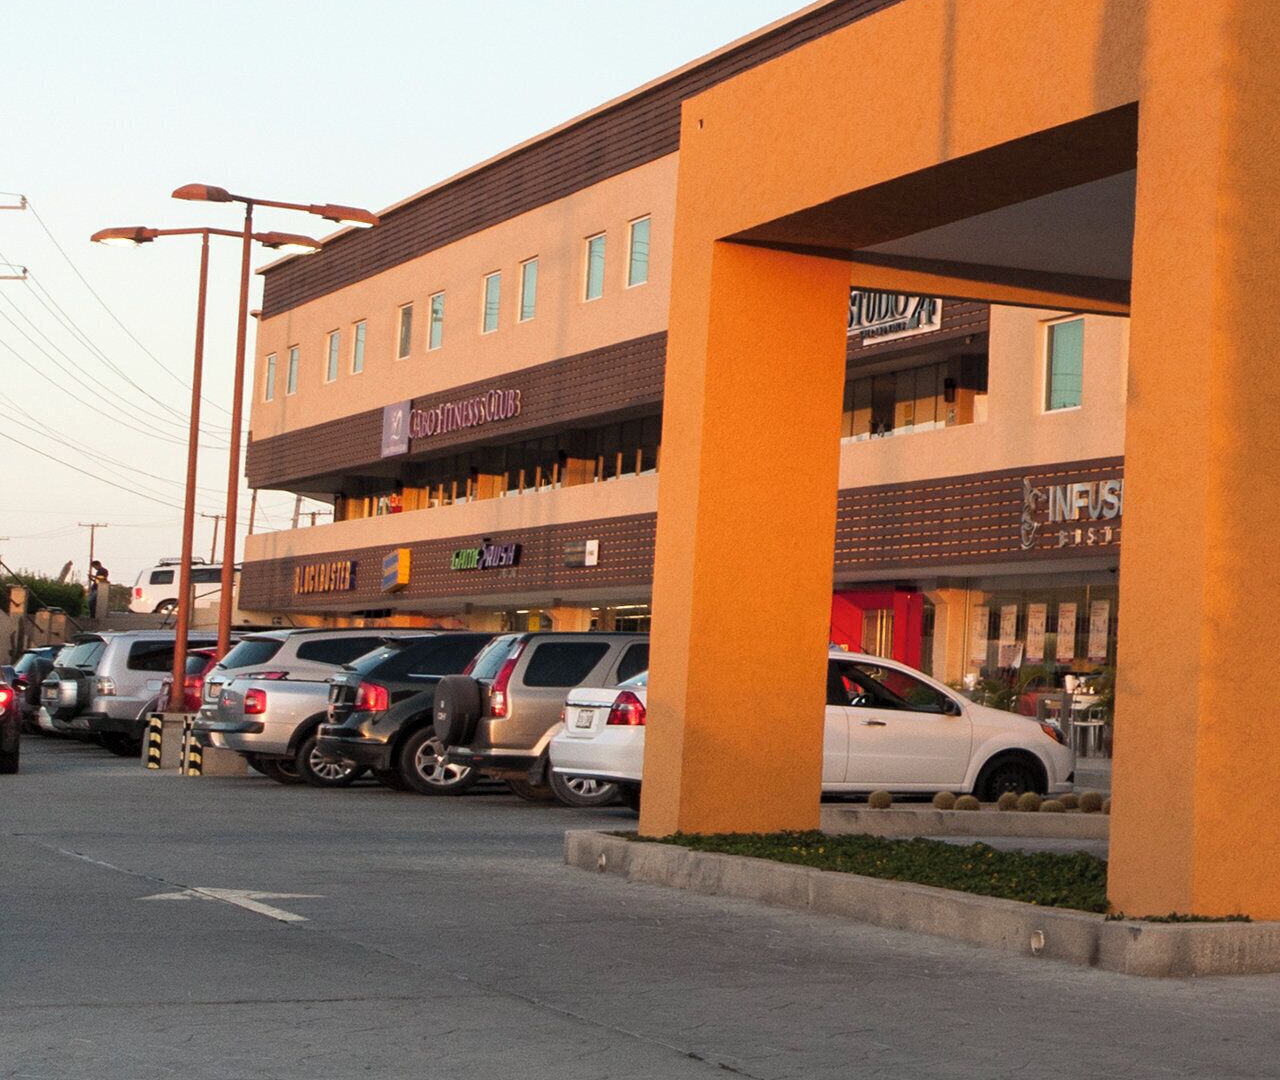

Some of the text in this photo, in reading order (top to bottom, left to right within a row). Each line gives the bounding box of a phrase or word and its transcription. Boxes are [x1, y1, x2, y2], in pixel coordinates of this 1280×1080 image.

[438, 397, 485, 432] FITNESS
[485, 388, 521, 422] CLUB
[450, 542, 520, 570] GAME RUSH
[293, 560, 356, 595] BLOCKBUSTER
